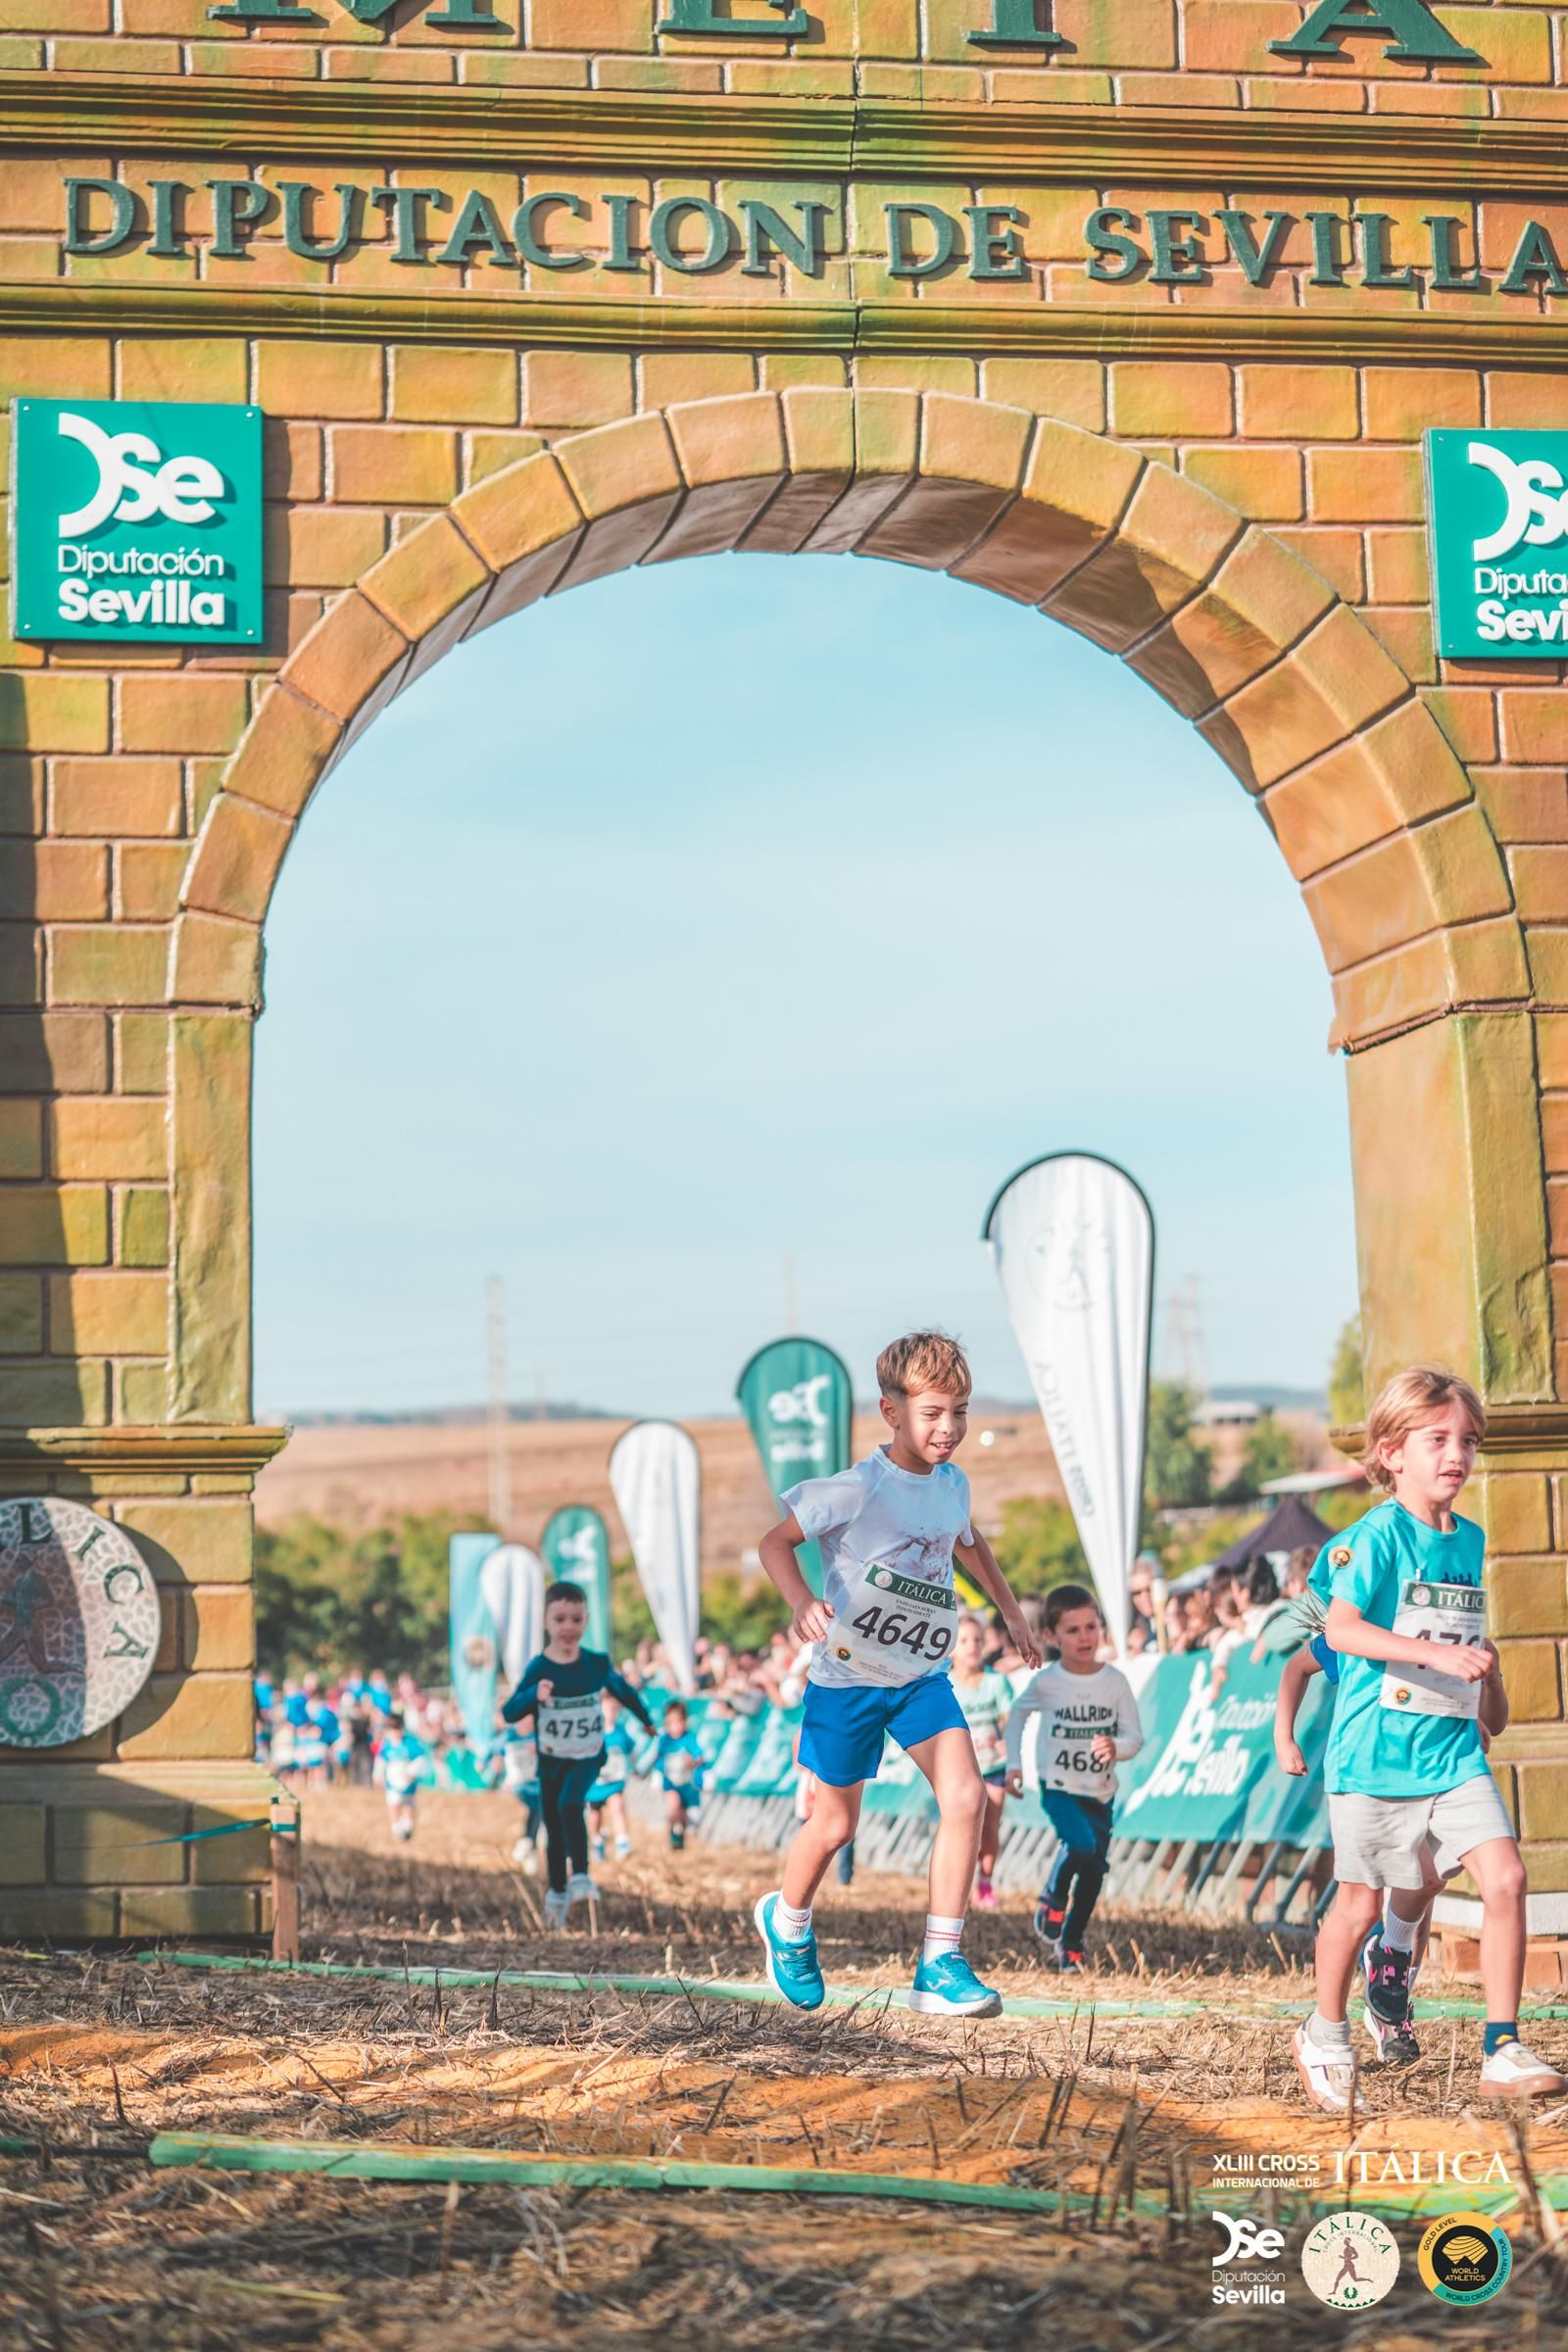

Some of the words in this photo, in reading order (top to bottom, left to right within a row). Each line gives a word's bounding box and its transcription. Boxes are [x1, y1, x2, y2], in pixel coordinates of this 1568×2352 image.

[64, 177, 820, 276] DIPUTACION
[884, 203, 1023, 279] DE
[1085, 207, 1568, 294] SEVILLA
[58, 544, 224, 579] Diputación
[58, 578, 224, 625] Sevilla
[897, 1581, 947, 1604] ITÁLICA
[853, 1606, 952, 1661] 4649
[545, 1715, 603, 1740] 4754
[1054, 1749, 1109, 1774] 468
